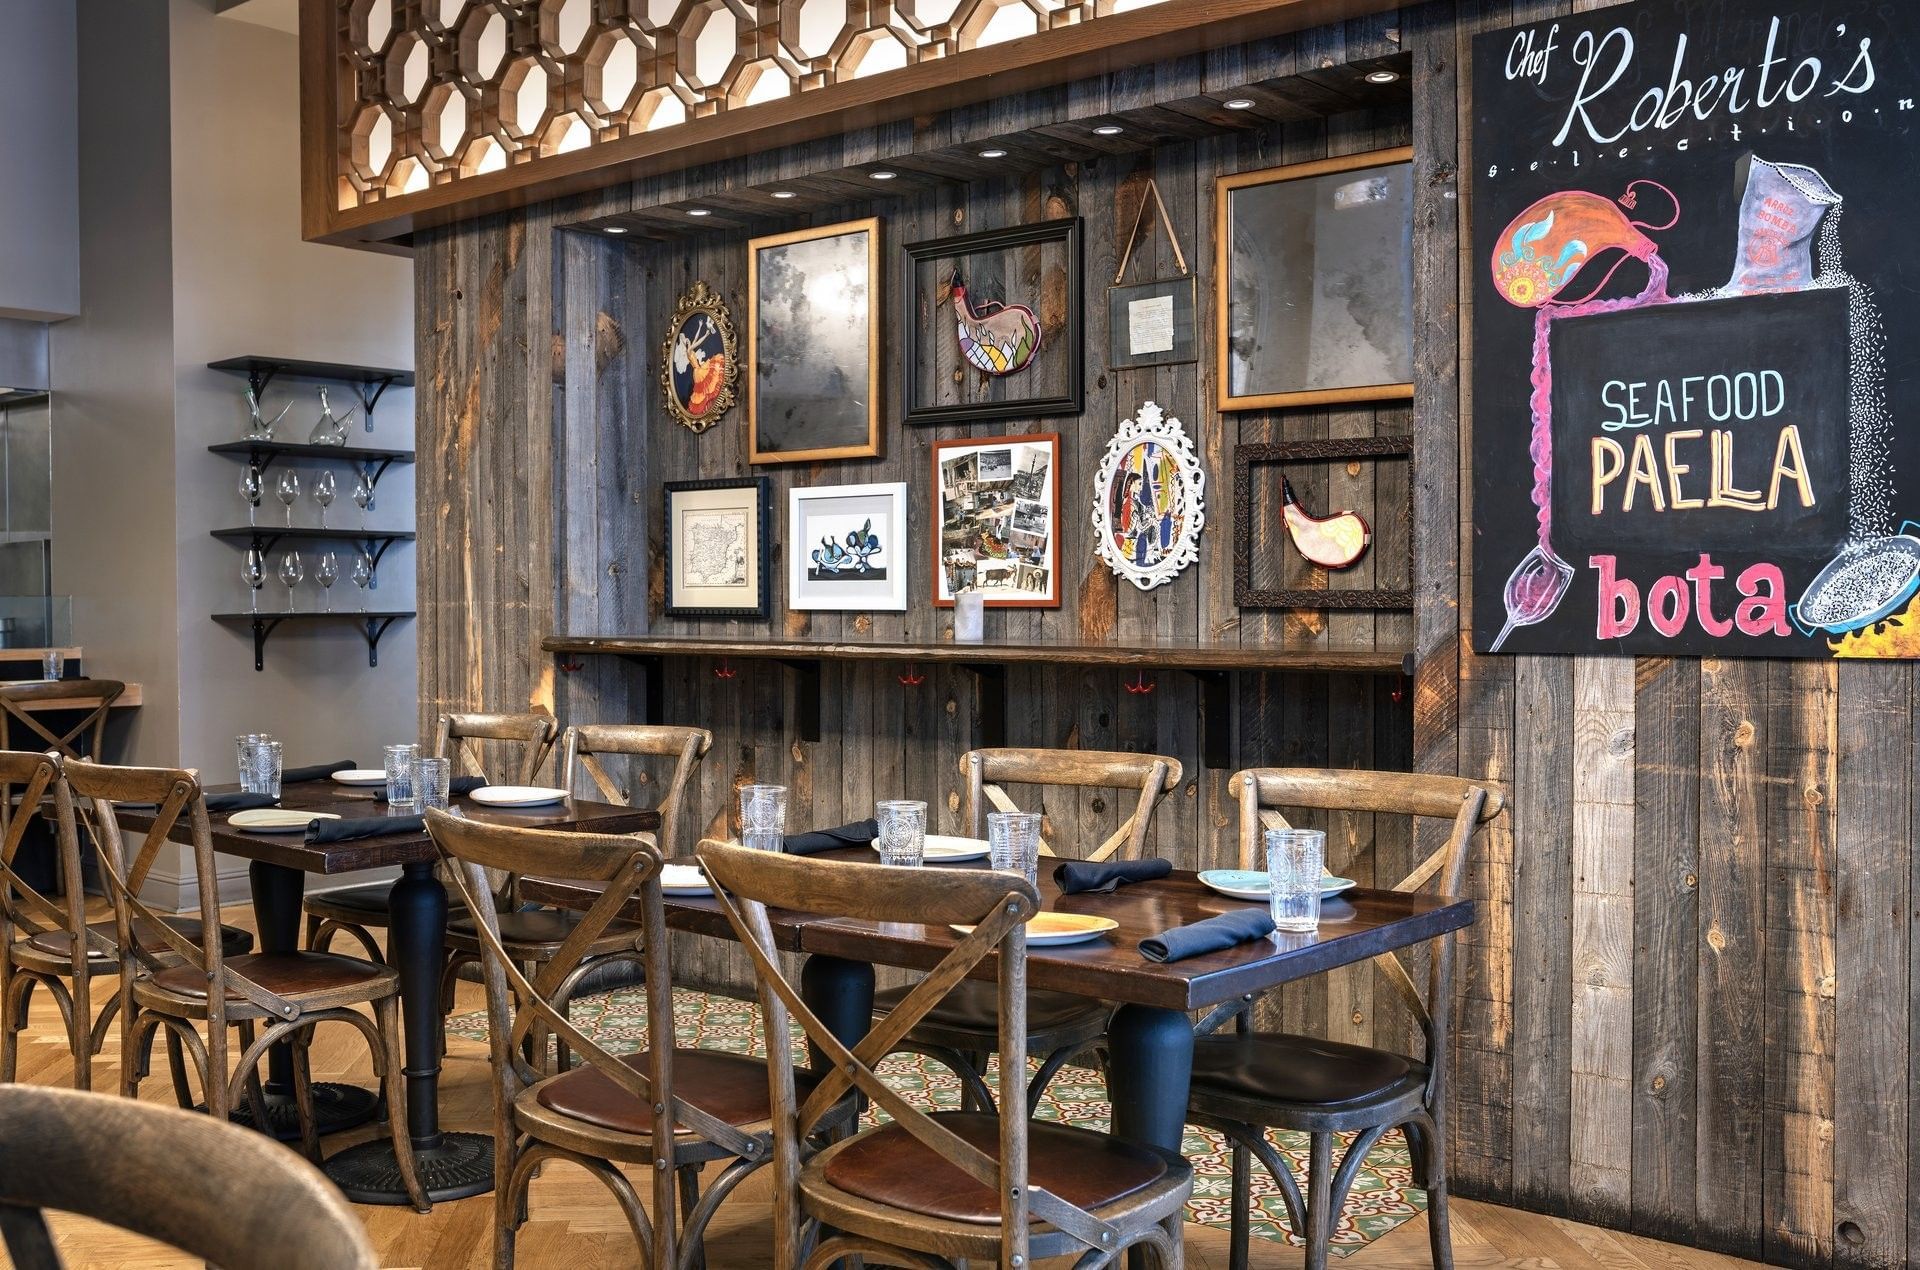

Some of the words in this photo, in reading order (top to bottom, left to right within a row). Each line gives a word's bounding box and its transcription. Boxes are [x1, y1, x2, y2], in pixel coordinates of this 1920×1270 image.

[1505, 24, 1559, 85] Chef
[1552, 15, 1876, 147] Roberto's
[1756, 210, 1797, 235] BOMBA
[1601, 369, 1785, 431] SEAFOOD
[1591, 424, 1816, 515] PAELLA
[1588, 553, 1792, 640] bota
